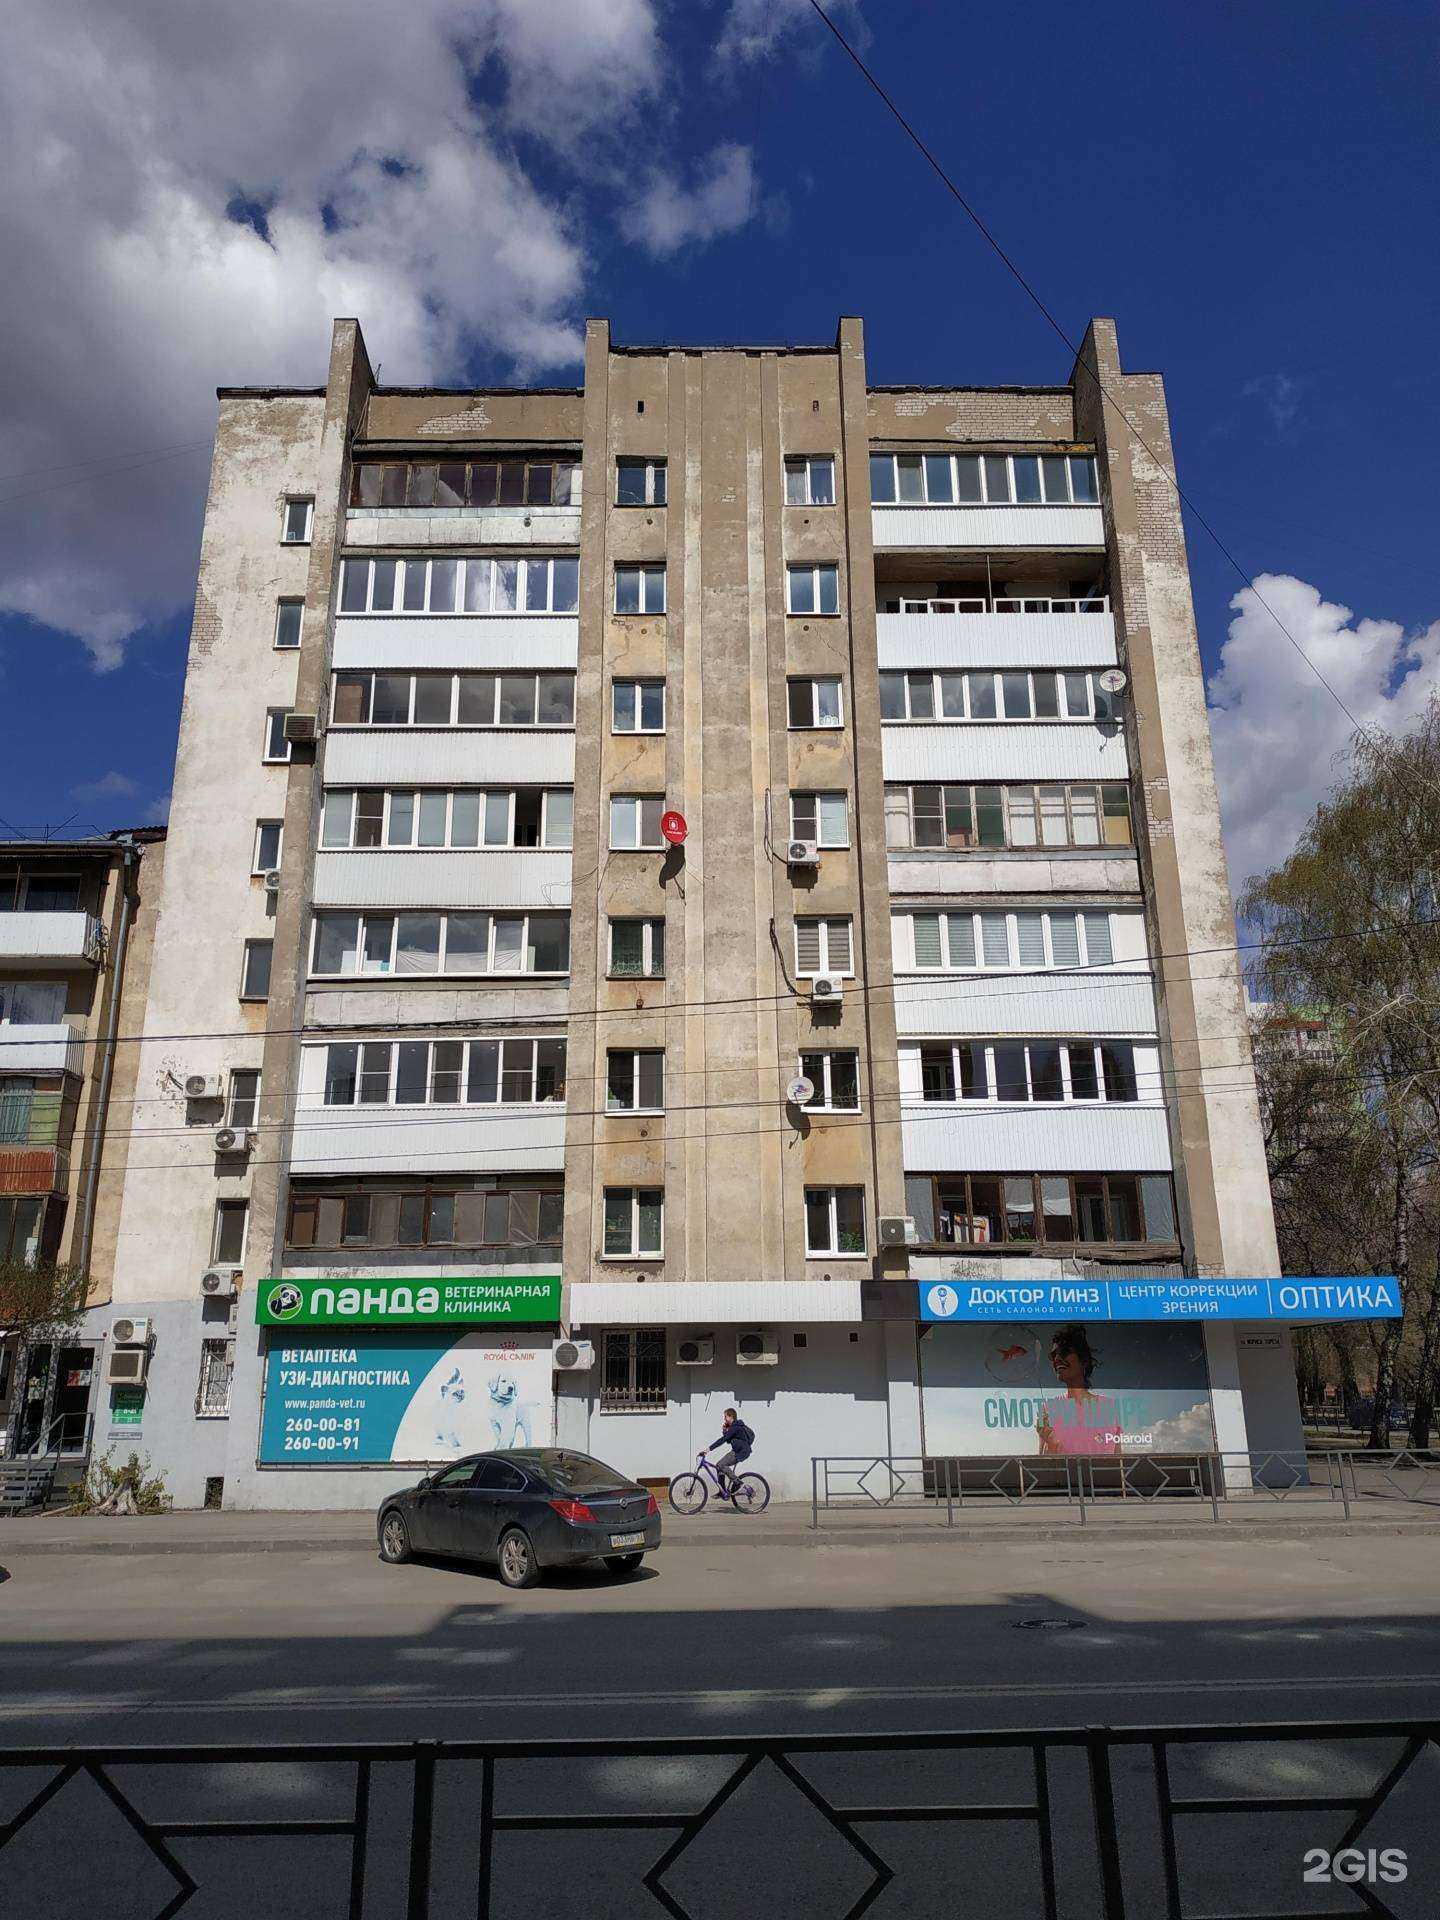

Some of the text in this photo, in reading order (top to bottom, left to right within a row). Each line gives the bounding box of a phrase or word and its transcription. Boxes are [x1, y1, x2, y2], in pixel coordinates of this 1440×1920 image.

[444, 1285, 551, 1298] ВЕТЕРИНАРНАЯ
[968, 1286, 1100, 1307] ДОКТОР ЛИНЗ
[1118, 1285, 1258, 1299] ЦЕНТР КОРРЕКЦИИ
[1279, 1285, 1393, 1310] ОПТИКА
[444, 1301, 512, 1313] КЛИНИКА
[1161, 1301, 1219, 1314] ЗРЕНИЯ
[281, 1349, 358, 1363] ВЕТАПТЕКА
[483, 1353, 535, 1361] ROYAL CANIN
[279, 1370, 411, 1388] УЗИ-ДИАГНОСТИКА
[284, 1398, 366, 1411] www.panda-vet.ru
[285, 1418, 360, 1432] 260-00-81
[284, 1437, 359, 1451] 260-00-91
[1104, 1432, 1153, 1445] Polaroid
